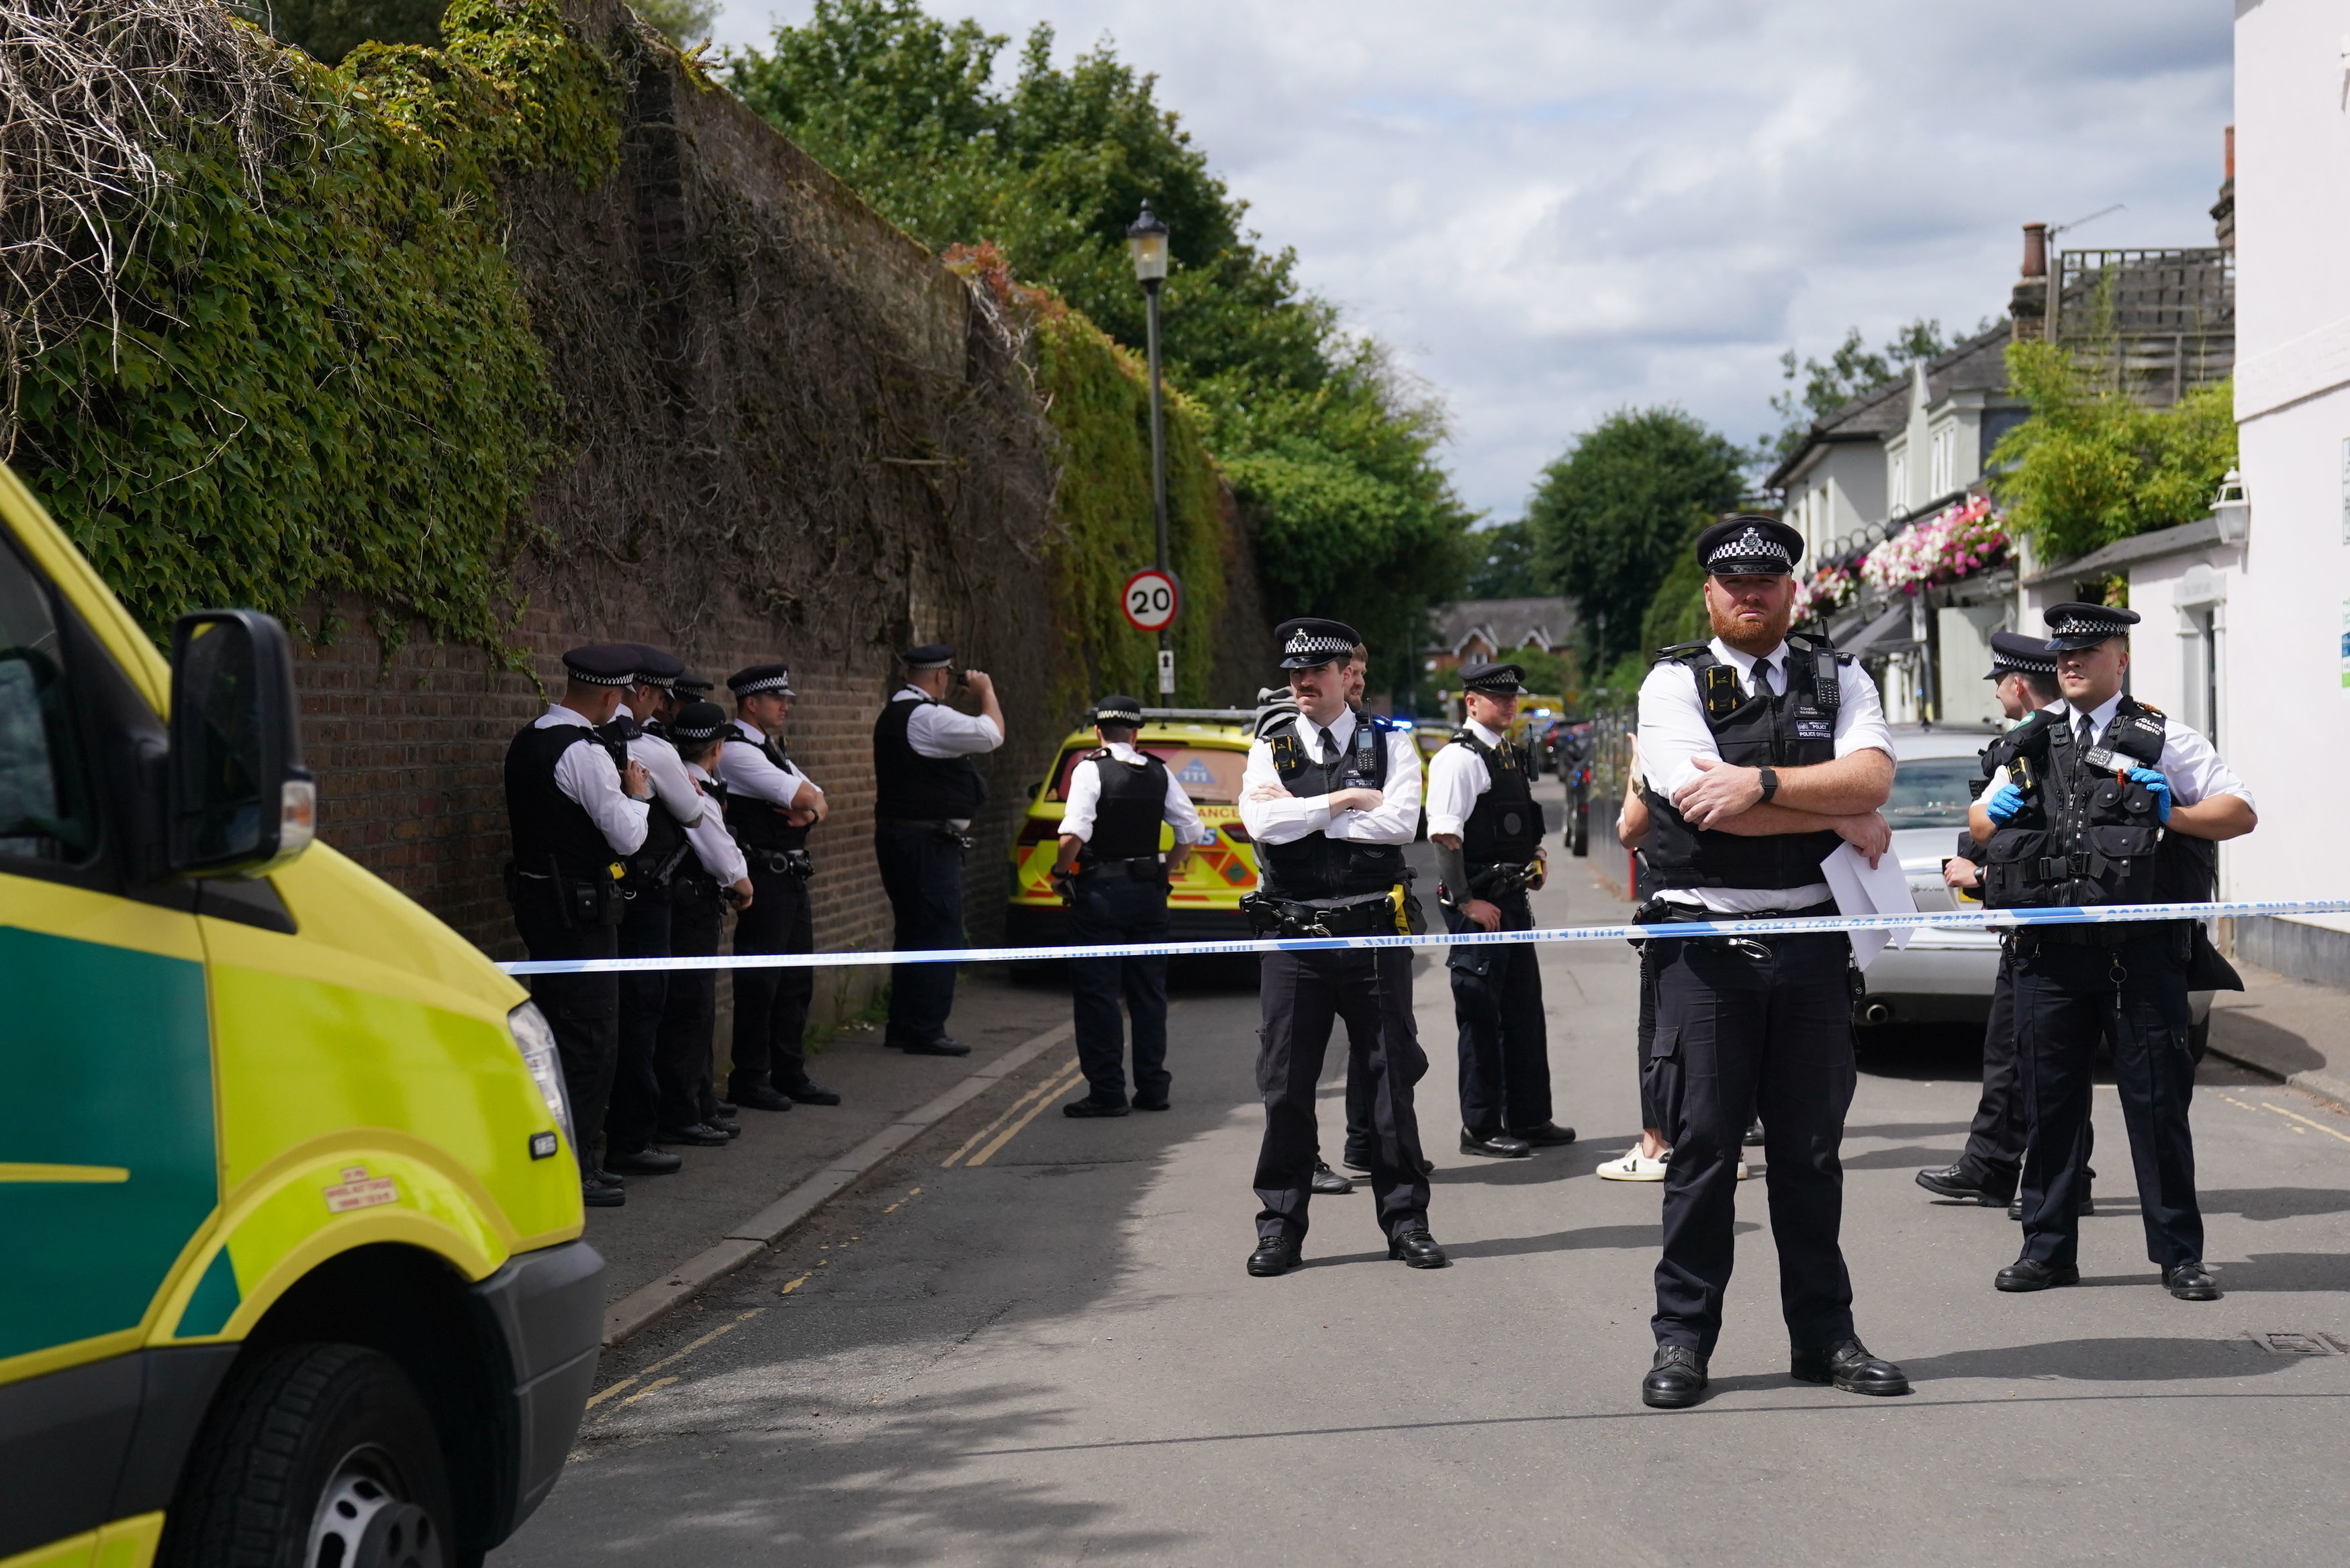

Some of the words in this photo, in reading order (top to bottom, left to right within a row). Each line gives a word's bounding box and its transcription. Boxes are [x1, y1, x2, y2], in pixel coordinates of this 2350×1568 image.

[1131, 587, 1170, 614] 20
[2135, 721, 2161, 736] MEDIC
[1182, 771, 1207, 782] 111
